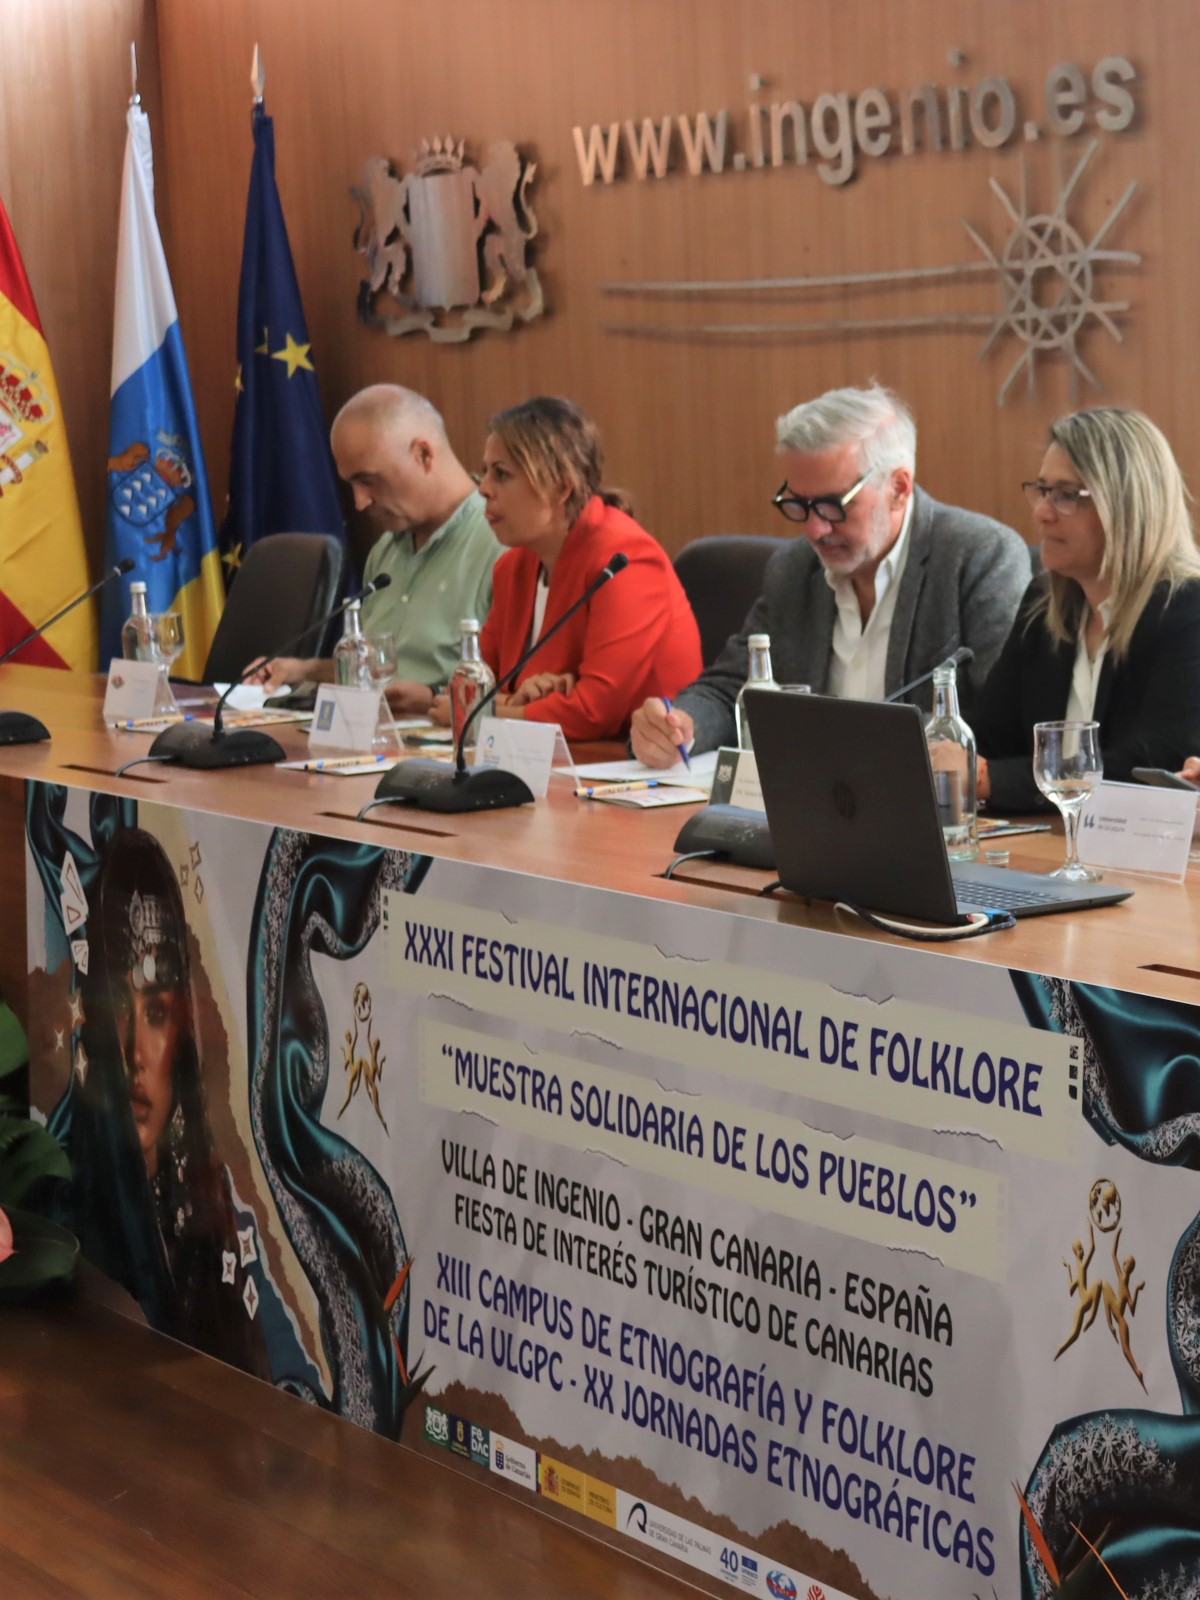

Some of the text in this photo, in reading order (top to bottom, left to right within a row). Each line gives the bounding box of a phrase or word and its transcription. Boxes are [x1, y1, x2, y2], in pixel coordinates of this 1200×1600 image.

[573, 49, 1136, 186] www.ingenio.es
[404, 921, 1043, 1117] XXXI FESTIVAL INTERNACIONAL DE FOLKLORE
[441, 1044, 977, 1234] “MUESTRA SOLIDARIA DE LOS PUEBLOS”
[441, 1138, 496, 1189] VILLA
[502, 1159, 528, 1201] DE
[534, 1169, 621, 1232] INGENIO
[639, 1204, 703, 1260] GRAN
[710, 1228, 822, 1301] CANARIA
[844, 1271, 953, 1347] ESPAÑA
[455, 1193, 934, 1398] FIESTA DE INTERÉS TURÍSTICO DE CANARIAS
[423, 1299, 451, 1346] DE
[457, 1313, 484, 1359] LA
[490, 1326, 563, 1392] ULGPC
[583, 1363, 614, 1415] XX
[621, 1380, 758, 1474] JORNADAS
[767, 1439, 996, 1577] ETNOGRÁFICAS
[436, 1252, 976, 1504] XIII CAMPUS DE ETNOGRAFÍA Y FOLKLORE
[720, 1547, 738, 1573] 40
